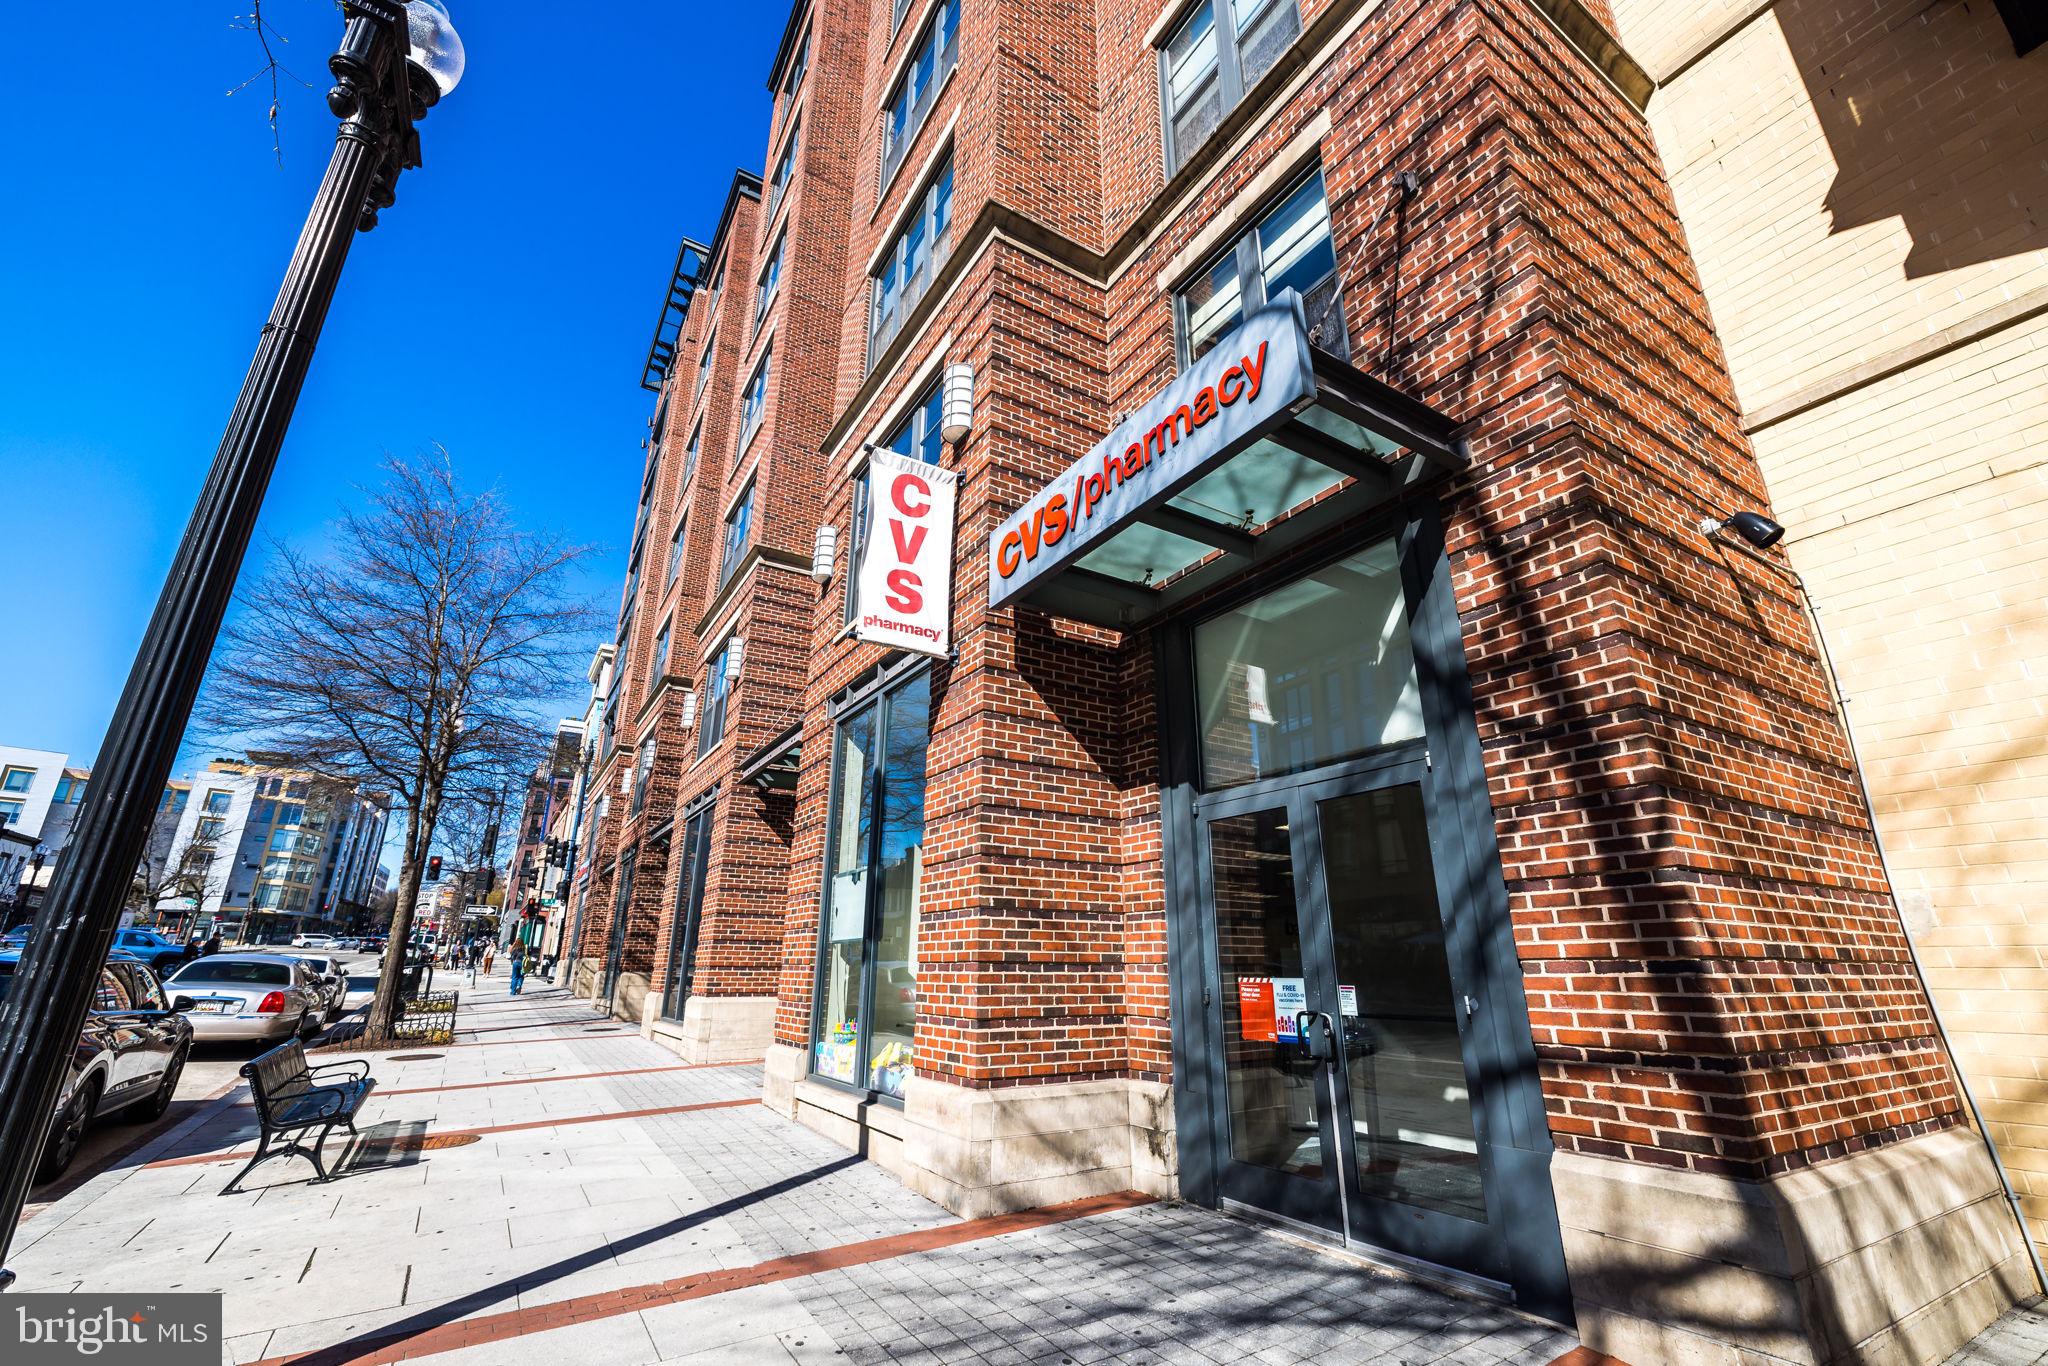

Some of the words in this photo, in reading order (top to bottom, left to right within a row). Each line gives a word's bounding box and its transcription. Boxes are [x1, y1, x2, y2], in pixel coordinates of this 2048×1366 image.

[997, 340, 1269, 579] CVS/pharmacy
[885, 473, 931, 615] CVS
[863, 614, 942, 643] pharmacy
